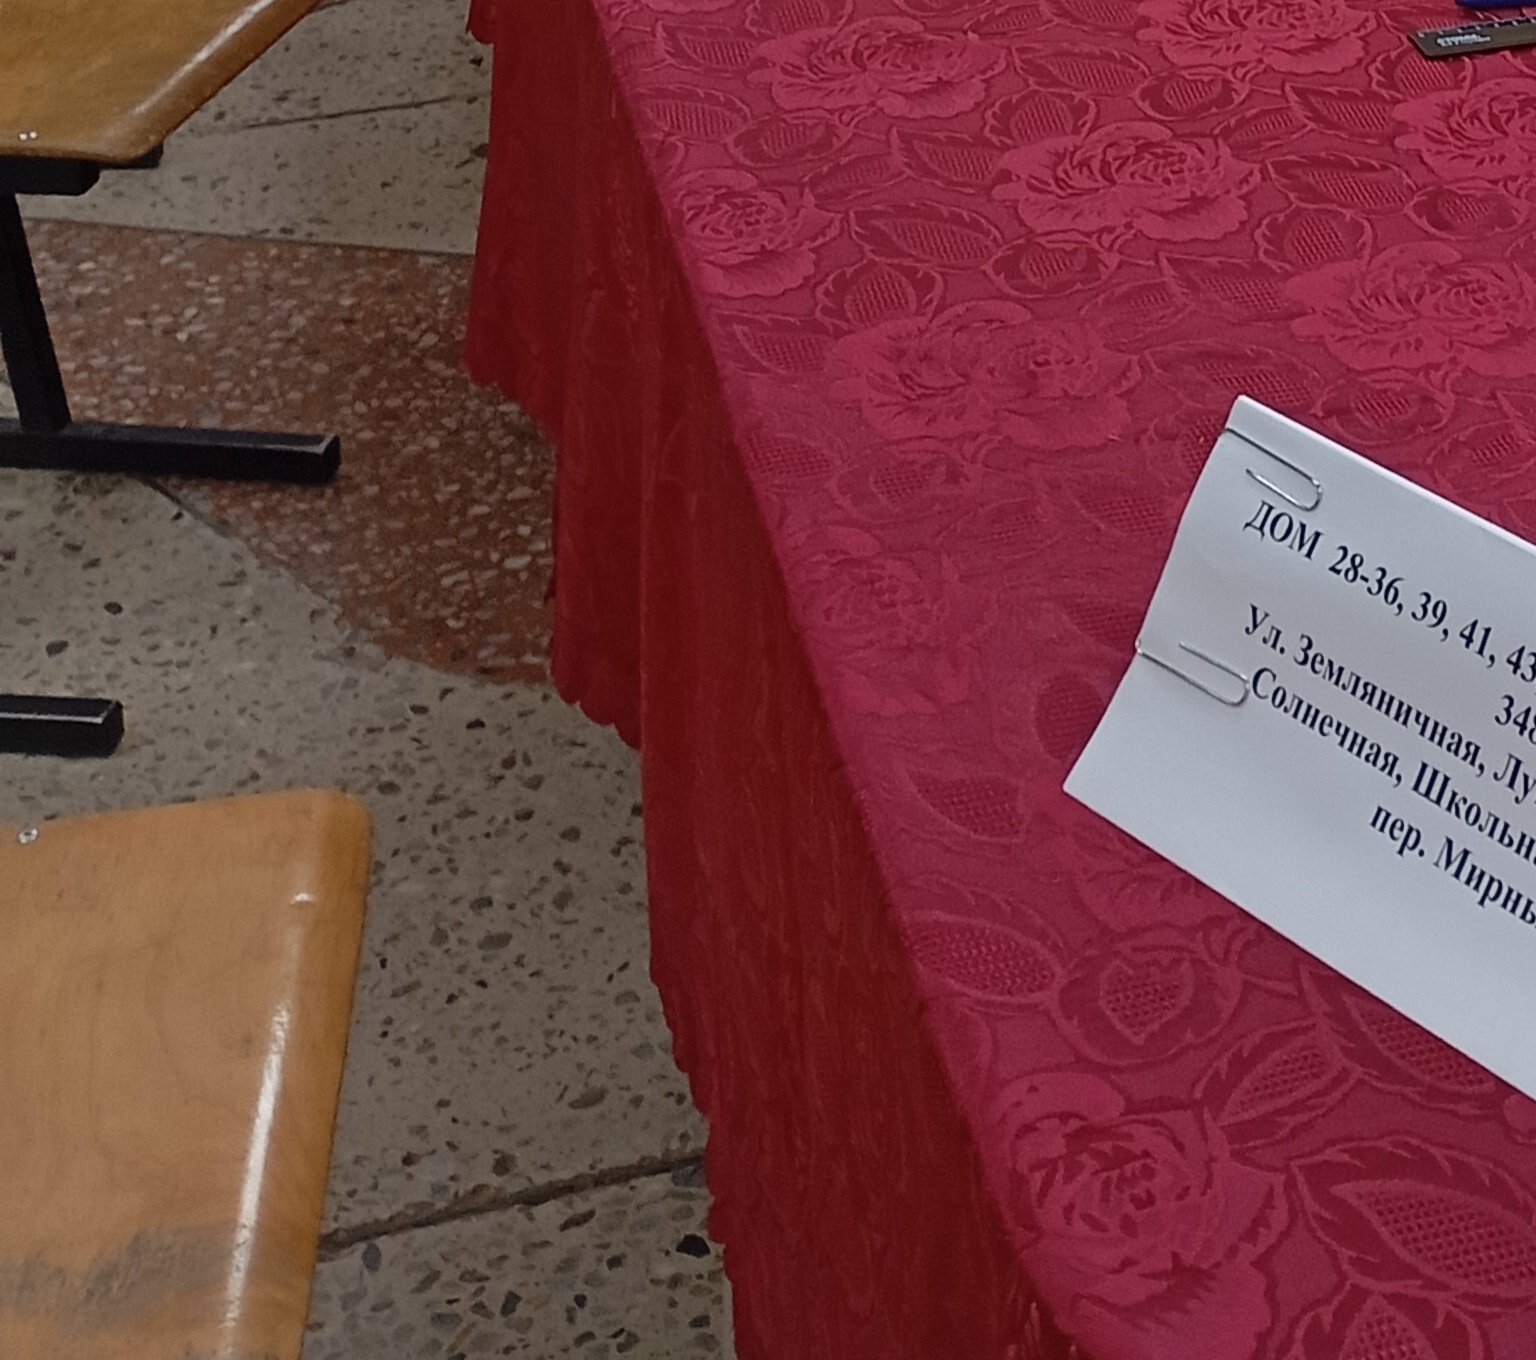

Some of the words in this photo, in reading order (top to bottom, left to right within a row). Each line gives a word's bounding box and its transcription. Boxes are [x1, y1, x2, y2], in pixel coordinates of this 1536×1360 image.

[1243, 500, 1324, 560] ДОМ
[1328, 545, 1405, 616] 28-36,
[1411, 591, 1449, 642] 39,
[1459, 619, 1496, 669] 41,
[1244, 602, 1286, 655] Ул.
[1293, 634, 1486, 777] Земляничная,
[1251, 666, 1402, 787] Солнечная,
[1369, 805, 1425, 857] пер.
